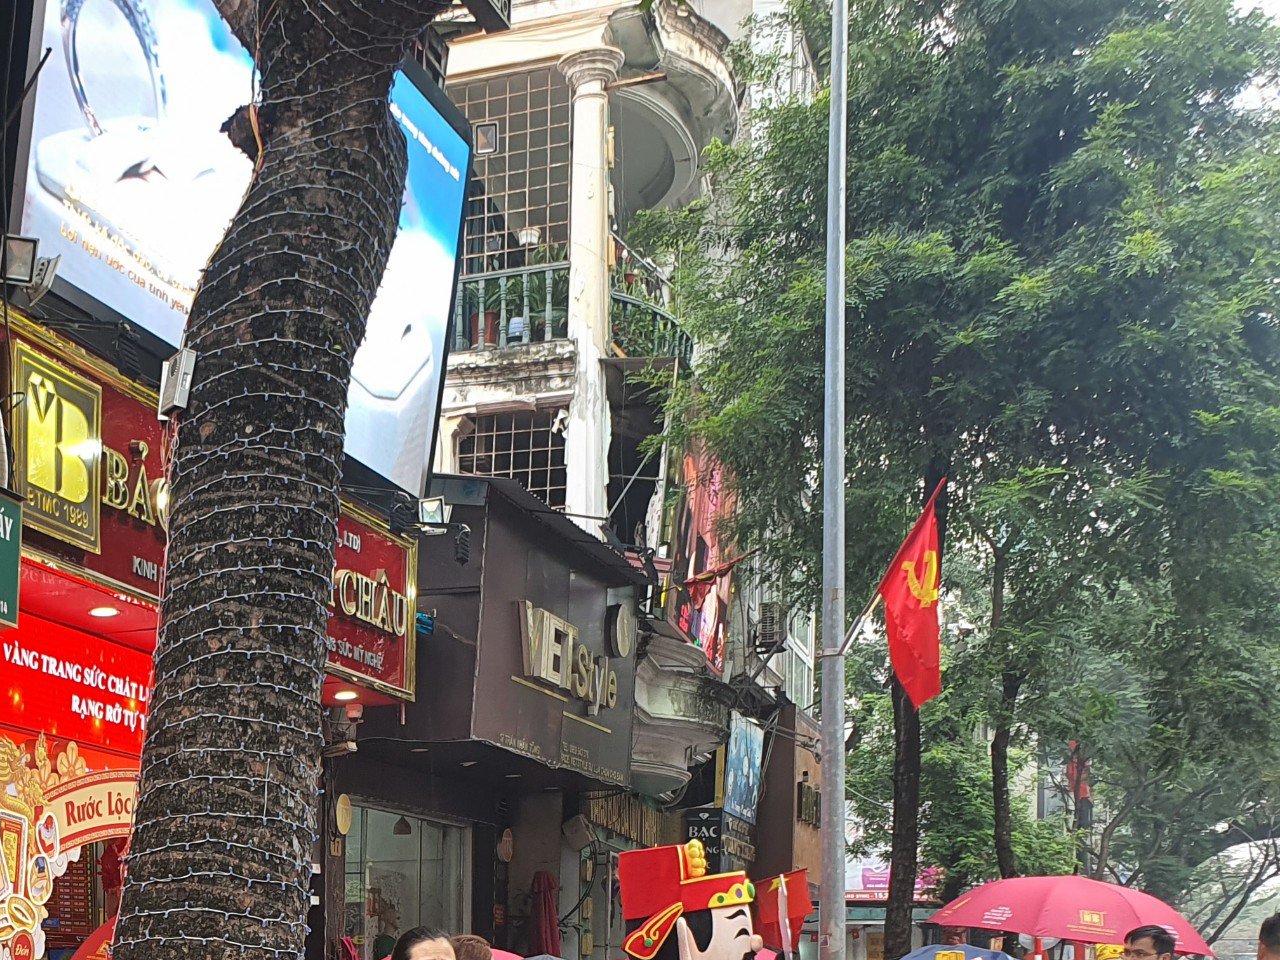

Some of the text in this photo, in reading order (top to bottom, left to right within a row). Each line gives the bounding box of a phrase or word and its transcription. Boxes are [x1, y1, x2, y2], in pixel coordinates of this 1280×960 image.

[64, 503, 89, 529] 1989
[132, 555, 157, 582] KINH
[337, 568, 408, 637] CHÂU
[3, 640, 39, 672] VÀNG
[40, 655, 82, 683] TRANG
[83, 663, 107, 687] SỨC
[71, 694, 104, 720] RẠNG
[65, 791, 132, 828] Rước Lộc
[15, 944, 29, 957] Đón
